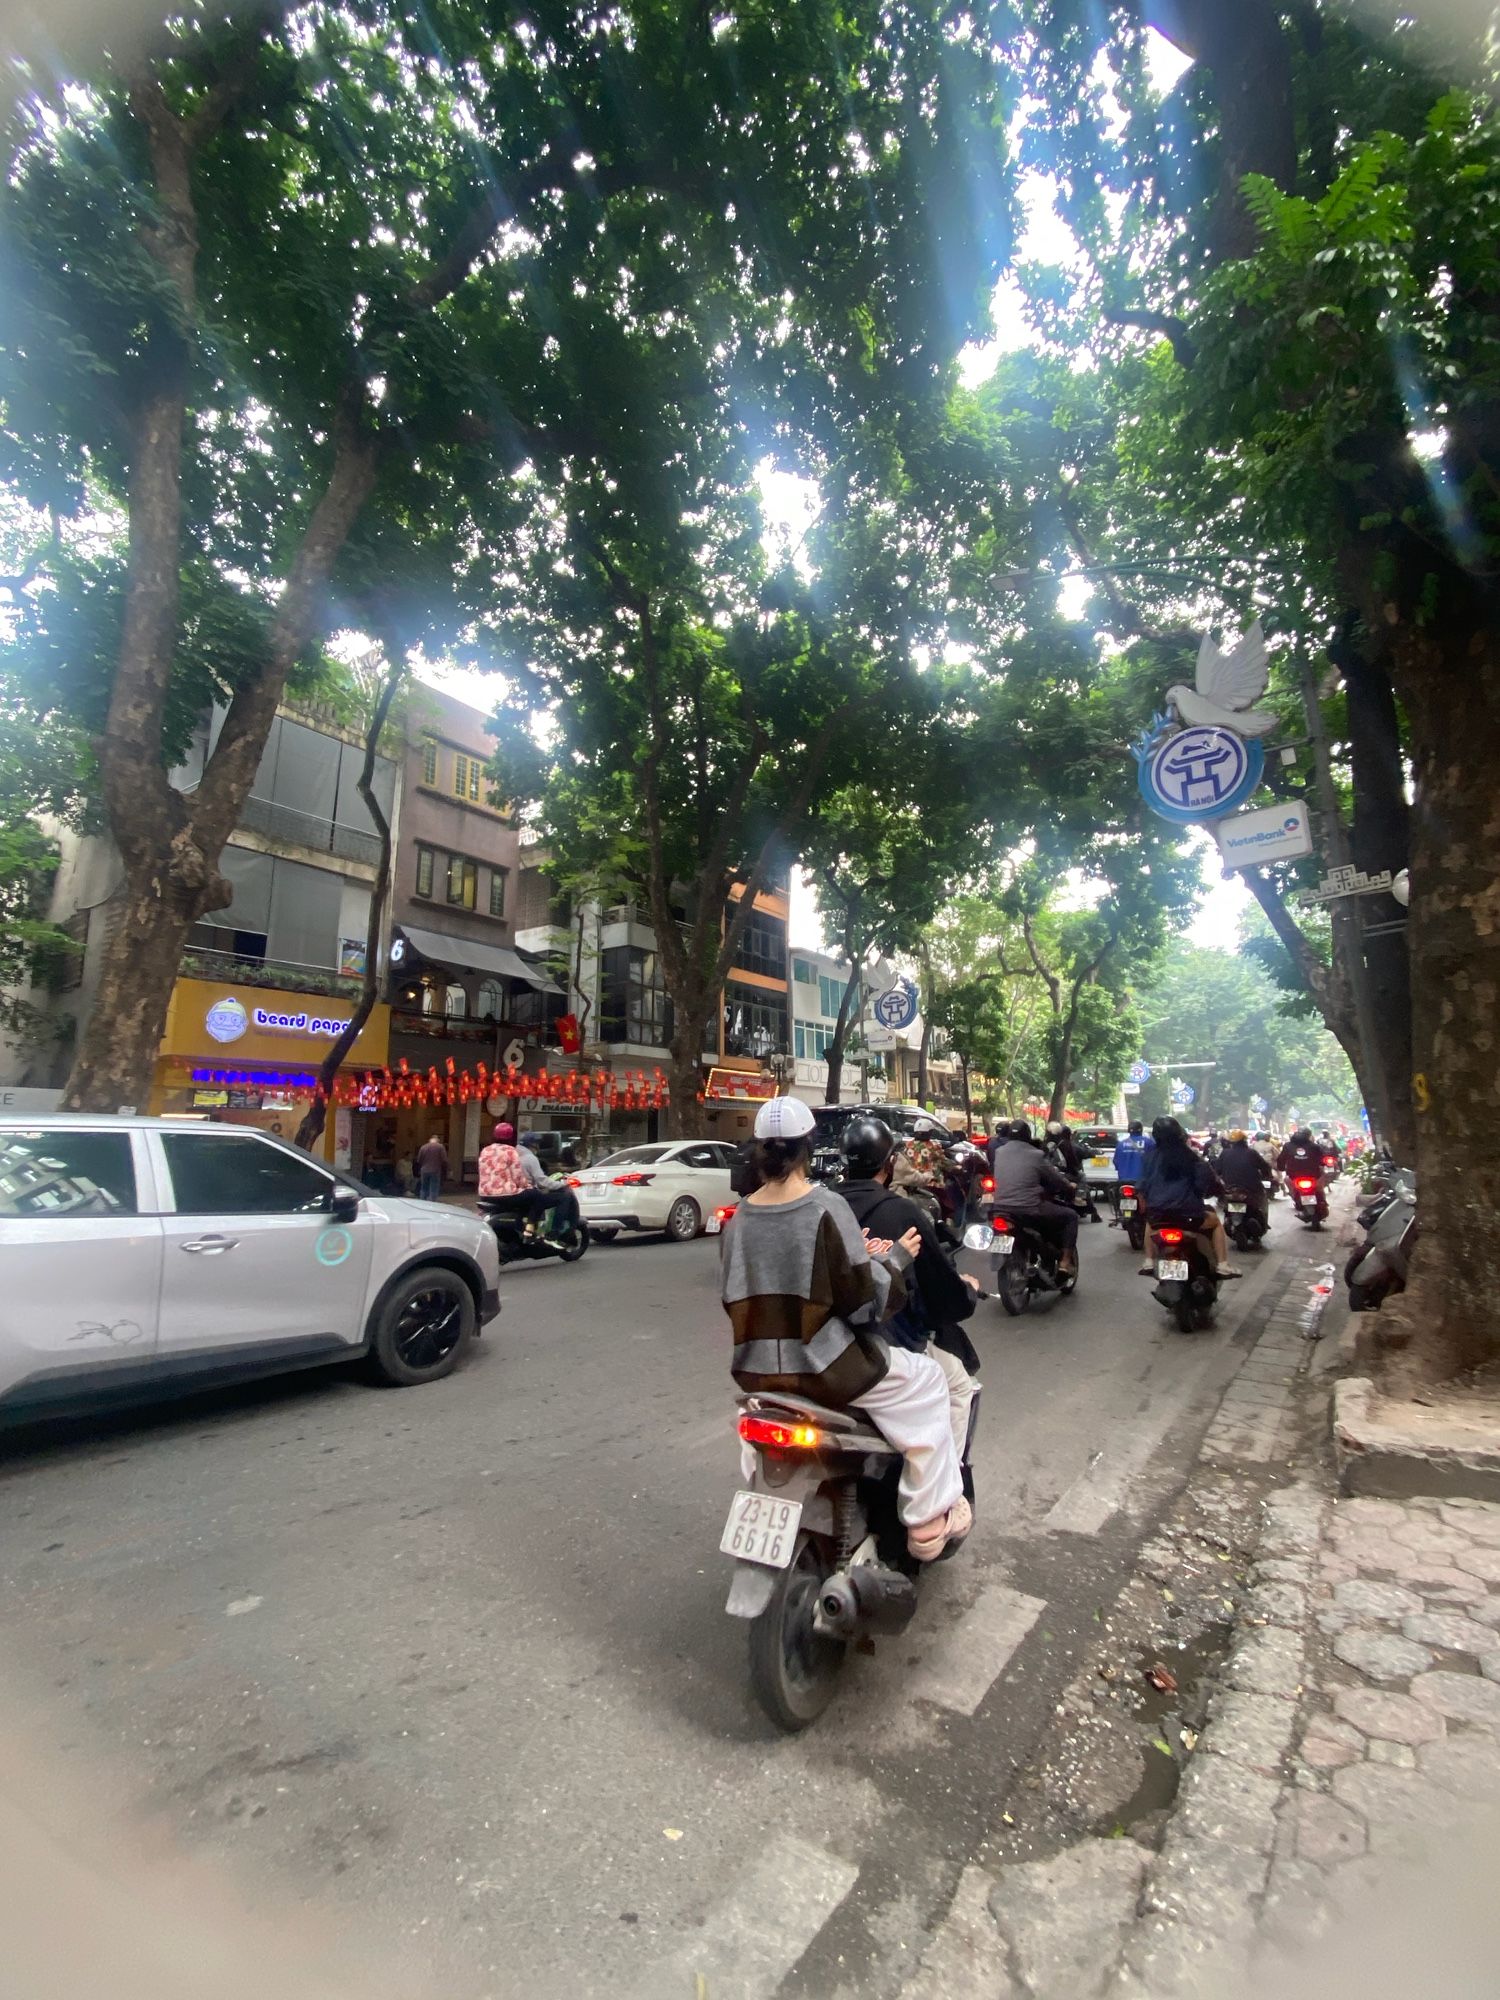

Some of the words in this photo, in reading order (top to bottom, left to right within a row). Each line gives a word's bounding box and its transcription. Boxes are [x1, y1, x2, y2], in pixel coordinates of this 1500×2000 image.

[1226, 828, 1286, 848] VietinBank
[391, 939, 404, 961] 6
[257, 1010, 306, 1028] beard
[503, 1038, 525, 1069] 6
[0, 1093, 15, 1106] E
[732, 1526, 783, 1559] 6616
